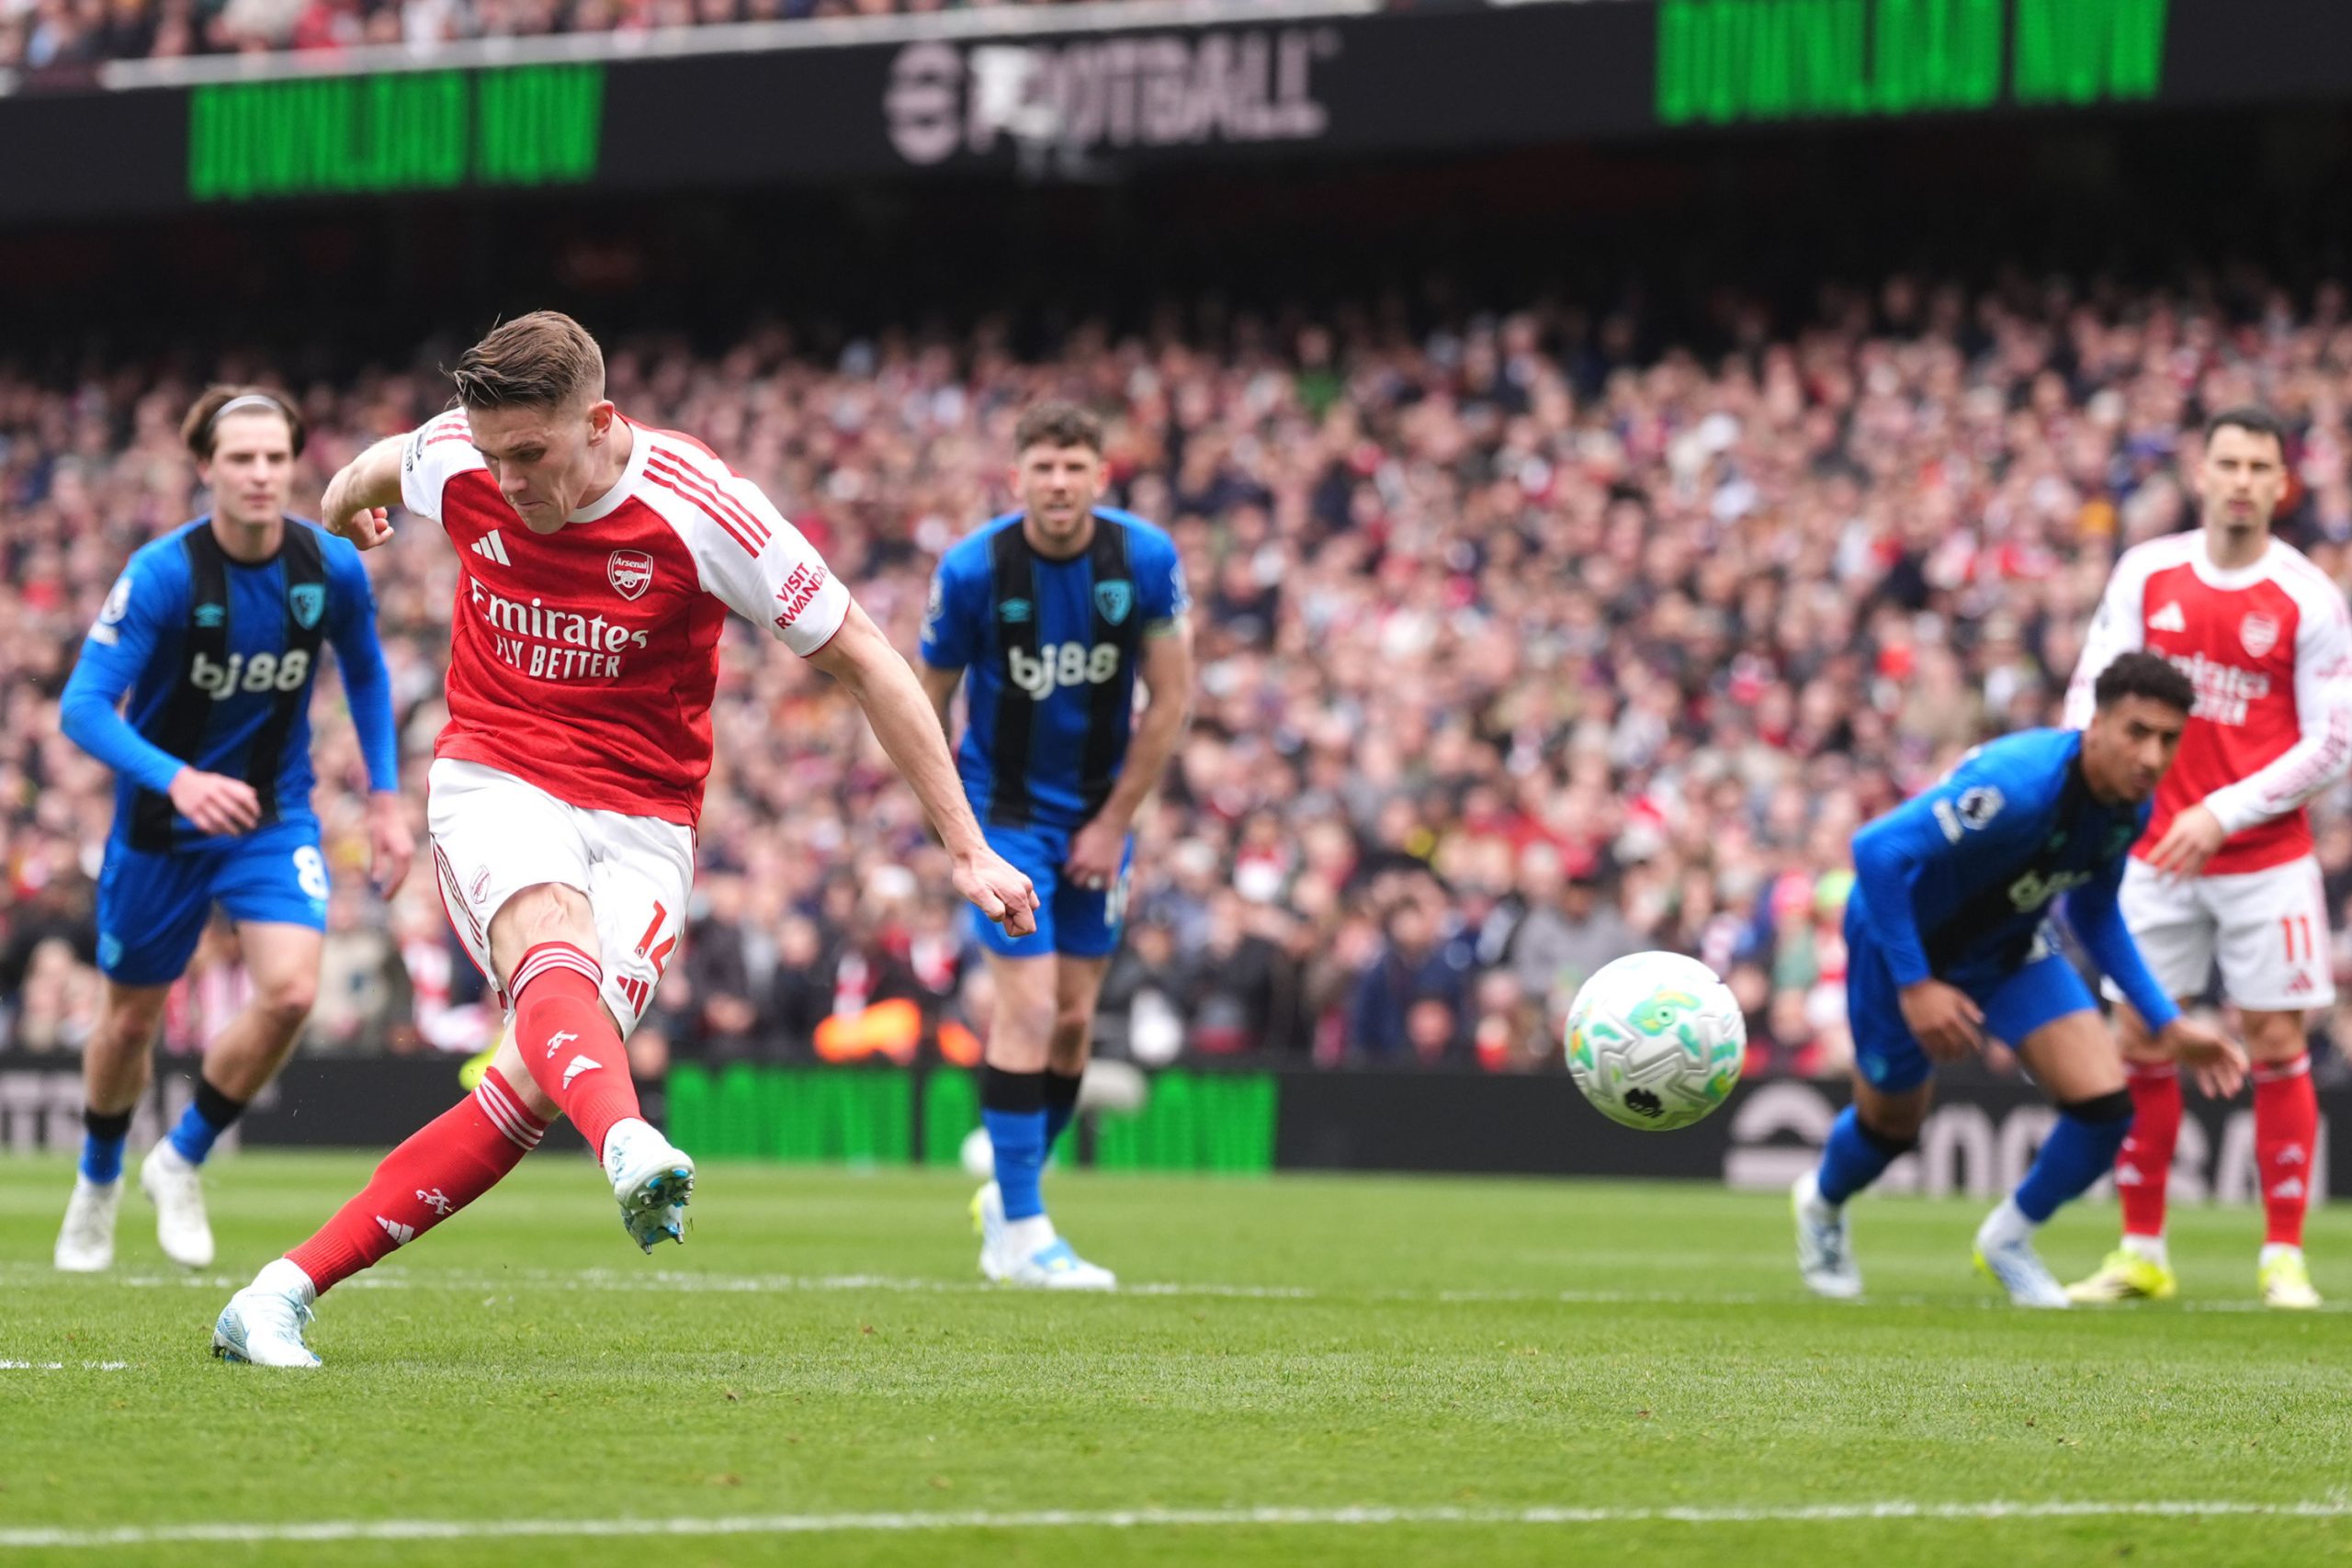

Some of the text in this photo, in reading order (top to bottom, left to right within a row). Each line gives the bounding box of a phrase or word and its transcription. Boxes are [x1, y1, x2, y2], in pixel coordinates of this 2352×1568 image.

[615, 557, 647, 570] Arsenal
[776, 562, 809, 602] VISIT
[469, 576, 649, 653] Emirates
[775, 565, 828, 630] RWANDA
[190, 649, 311, 701] bj88
[529, 645, 621, 680] BETTER
[1008, 641, 1120, 701] bj88
[292, 844, 329, 900] 8
[2278, 915, 2312, 963] 11
